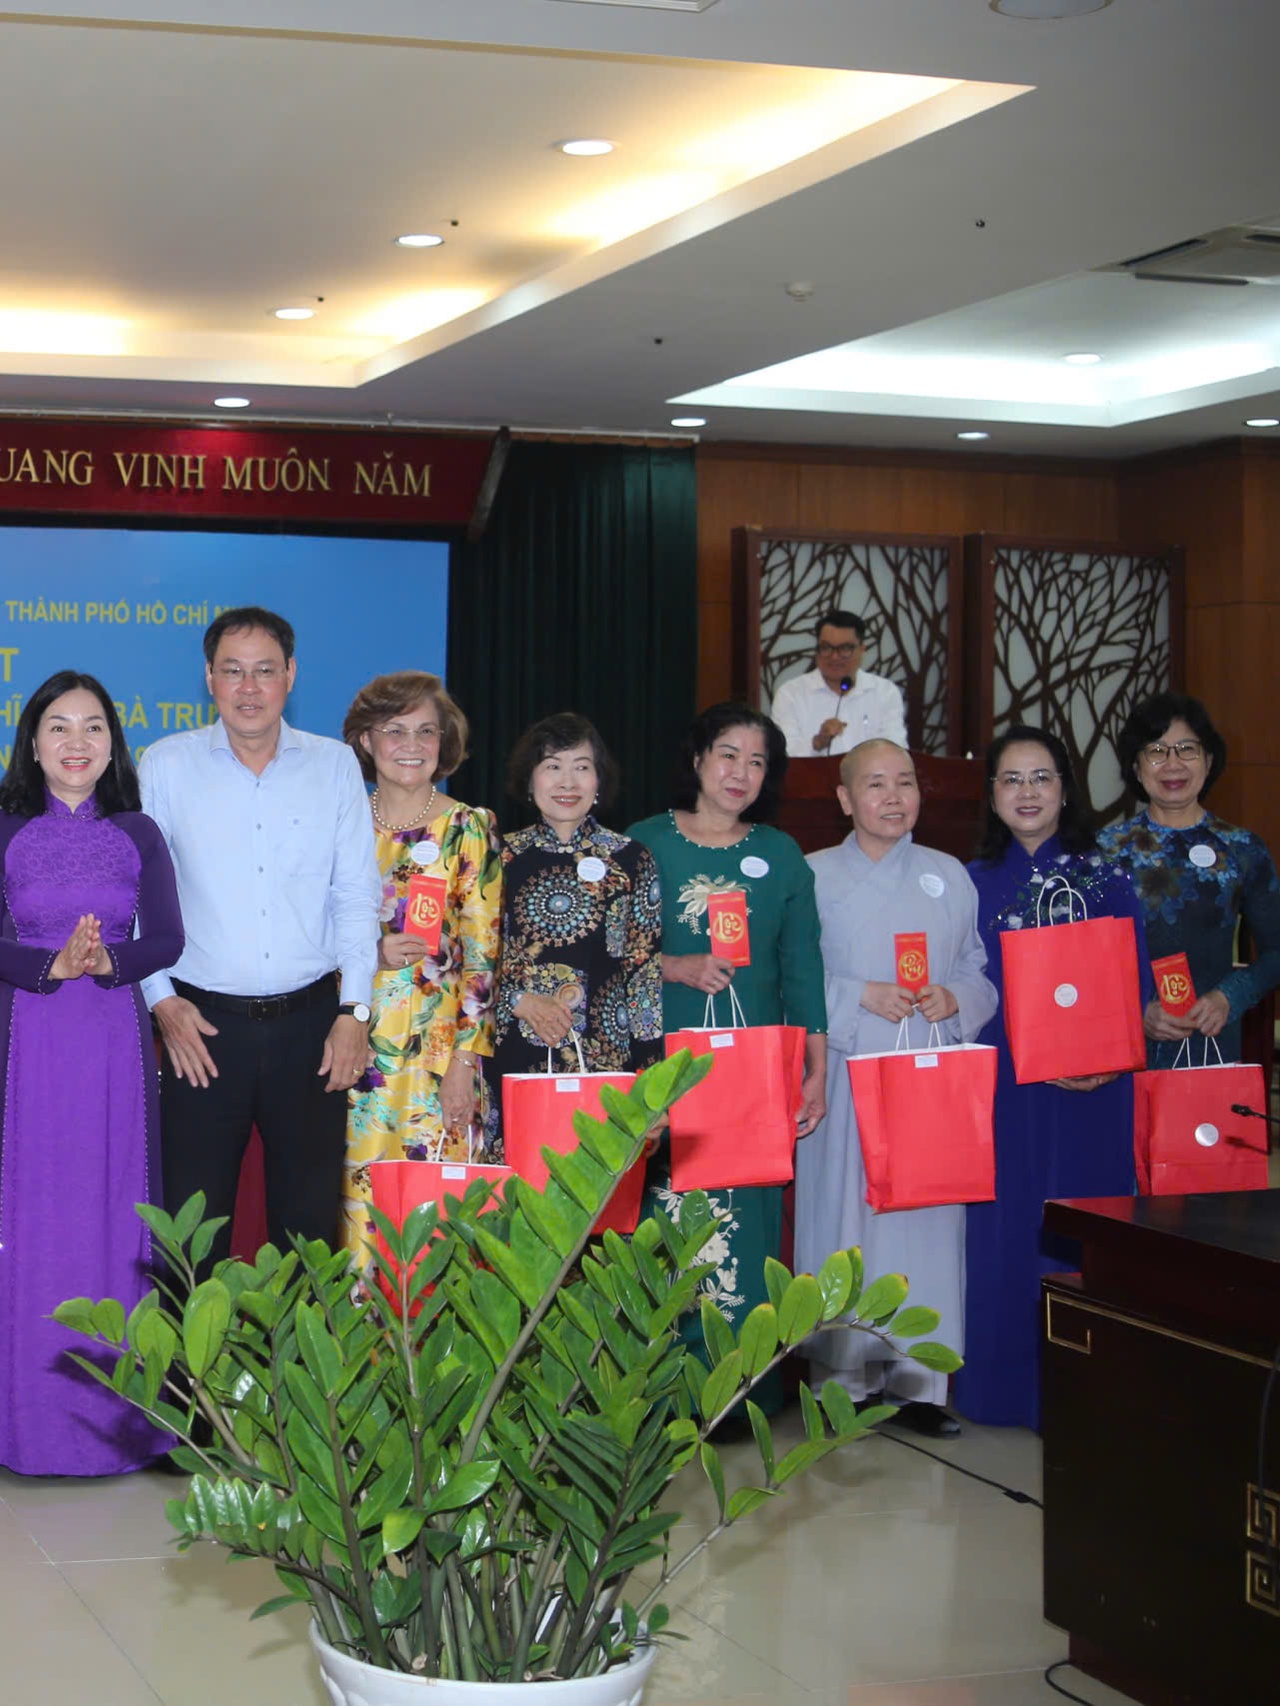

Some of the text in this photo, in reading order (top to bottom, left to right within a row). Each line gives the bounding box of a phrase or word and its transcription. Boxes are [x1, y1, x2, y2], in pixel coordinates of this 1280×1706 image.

[114, 452, 207, 489] VINH
[223, 448, 330, 492] MUÔN
[354, 451, 431, 497] NĂM
[6, 596, 79, 623] THÀNH
[85, 598, 131, 624] PHỐ
[136, 599, 168, 625] HỒ
[173, 599, 209, 625] CHÍ
